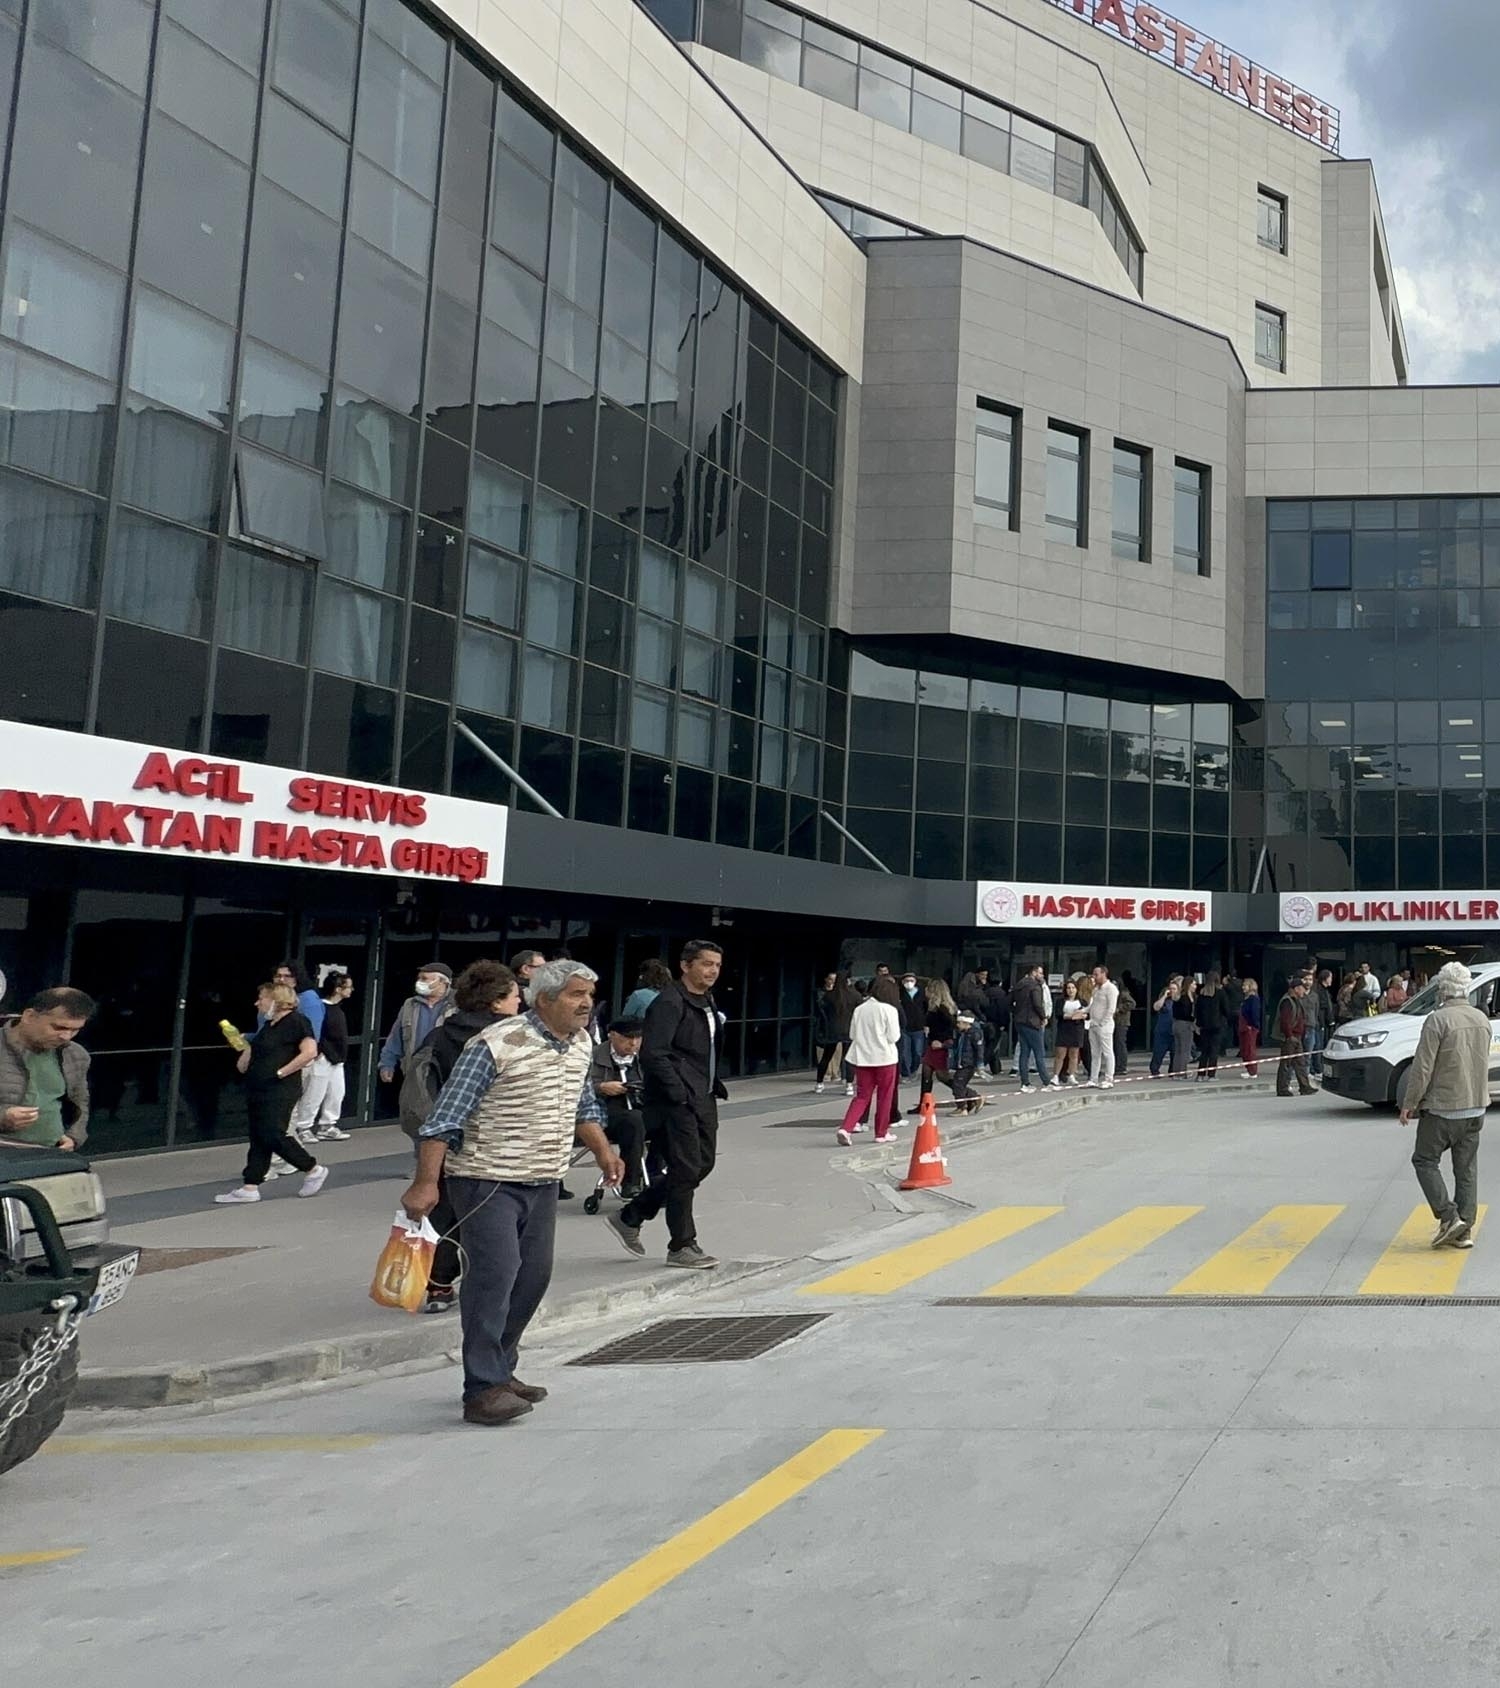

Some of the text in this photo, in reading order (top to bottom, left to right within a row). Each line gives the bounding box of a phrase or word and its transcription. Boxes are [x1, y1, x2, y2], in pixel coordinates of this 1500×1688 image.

[0, 789, 242, 854] AYAKTAN
[253, 820, 386, 869] HASTA
[1023, 894, 1136, 920] HASTANE
